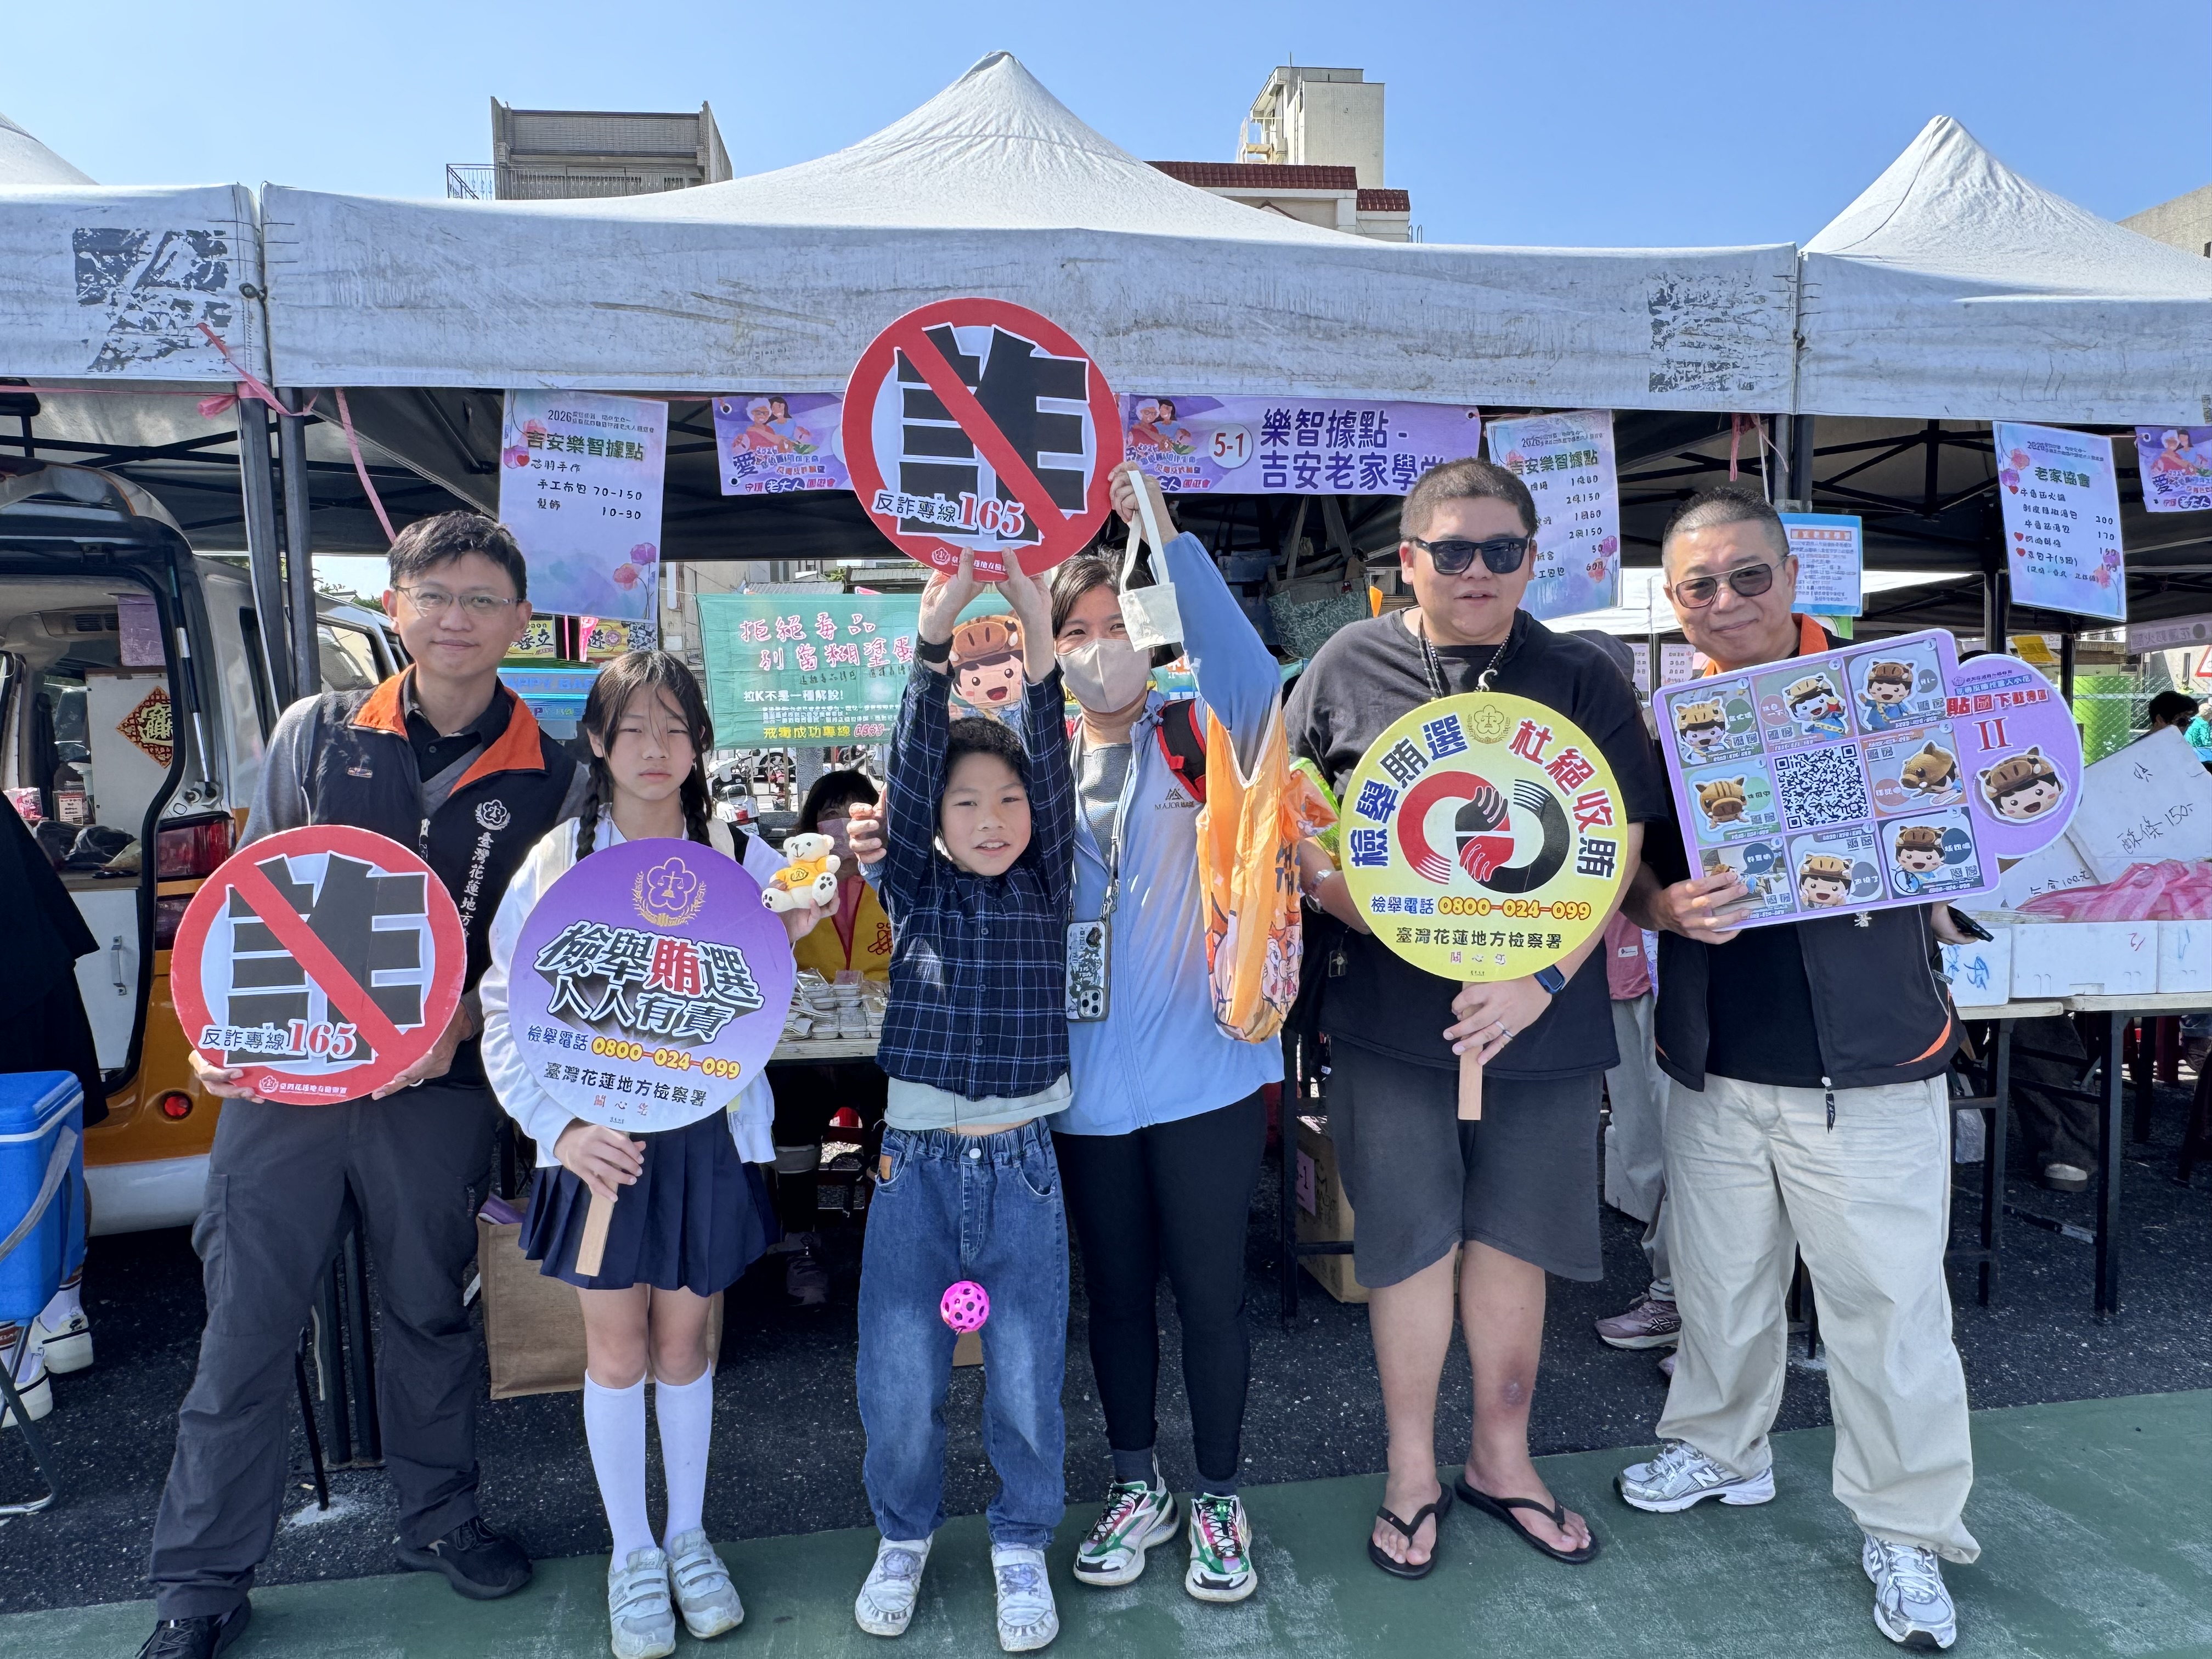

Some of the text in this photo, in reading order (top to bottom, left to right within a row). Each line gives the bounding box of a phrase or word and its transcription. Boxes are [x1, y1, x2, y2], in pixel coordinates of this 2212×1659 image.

[548, 410, 572, 422] 2026
[527, 430, 644, 461] 吉安樂智據點
[1214, 432, 1244, 458] 5-1
[733, 452, 758, 478] 愛
[537, 479, 642, 500] 手工布包 70-150
[602, 506, 641, 520] 10-30
[876, 492, 1025, 537] 反詐專線165
[740, 612, 876, 642] 拒絕毒品
[759, 636, 914, 671] 別當糊塗蛋
[763, 725, 850, 740] 戒毒成功專線
[1350, 713, 1468, 867] 檢舉賄選
[1509, 720, 1617, 879] 杜絕收賄
[1372, 896, 1592, 920] 檢舉電話 0800-024-099
[1396, 927, 1562, 949] 臺灣花蓮地方檢察署
[536, 921, 764, 1008] 檢舉賄選
[549, 975, 735, 1041] 人人有責
[201, 1019, 358, 1058] 反詐專線165
[527, 1025, 741, 1080] 檢舉電話 0800-024-099
[543, 1061, 708, 1107] 臺灣花蓮地方檢察署
